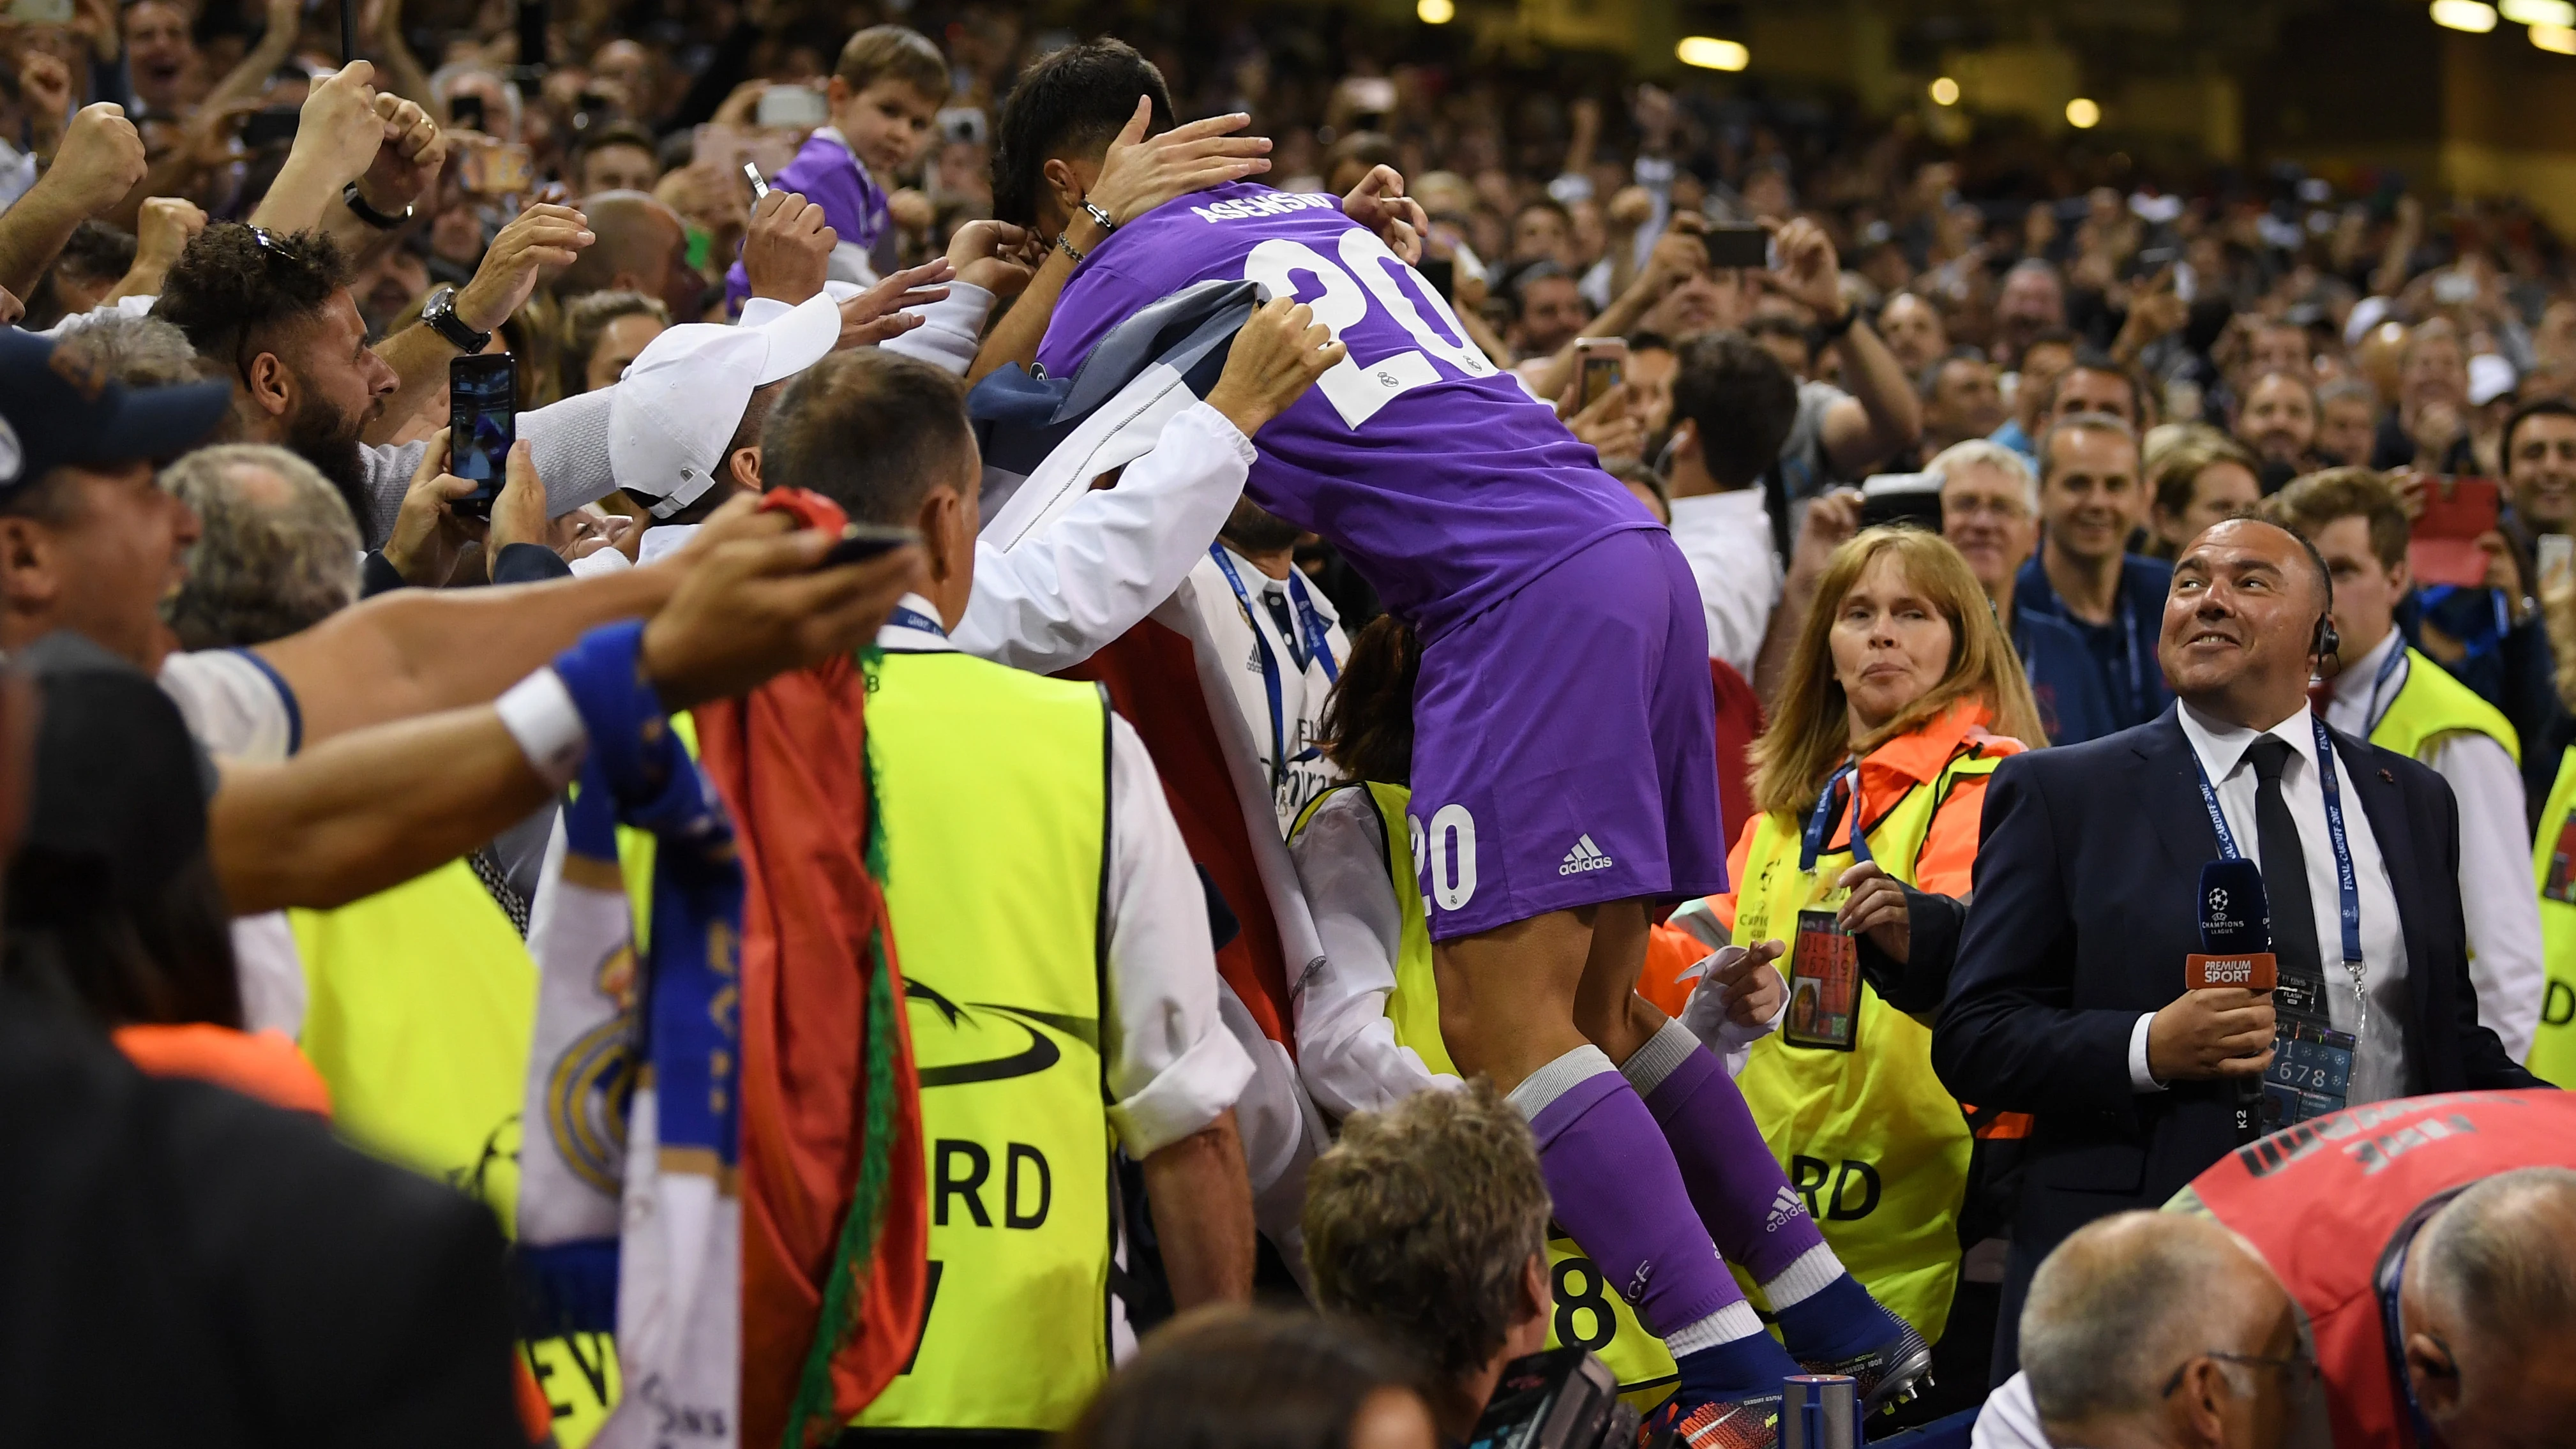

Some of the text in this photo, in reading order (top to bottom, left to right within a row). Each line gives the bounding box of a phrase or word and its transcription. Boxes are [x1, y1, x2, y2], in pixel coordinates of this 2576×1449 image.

[1244, 227, 1500, 431] 20
[1408, 804, 1477, 917] 20
[1559, 854, 1613, 875] adidas
[2204, 960, 2251, 971] PREMIUM
[2204, 970, 2251, 982] SPORT
[2236, 1109, 2248, 1129] K2
[933, 1138, 1051, 1231] RD
[1792, 1155, 1881, 1220] RD
[1766, 1204, 1805, 1233] adida
